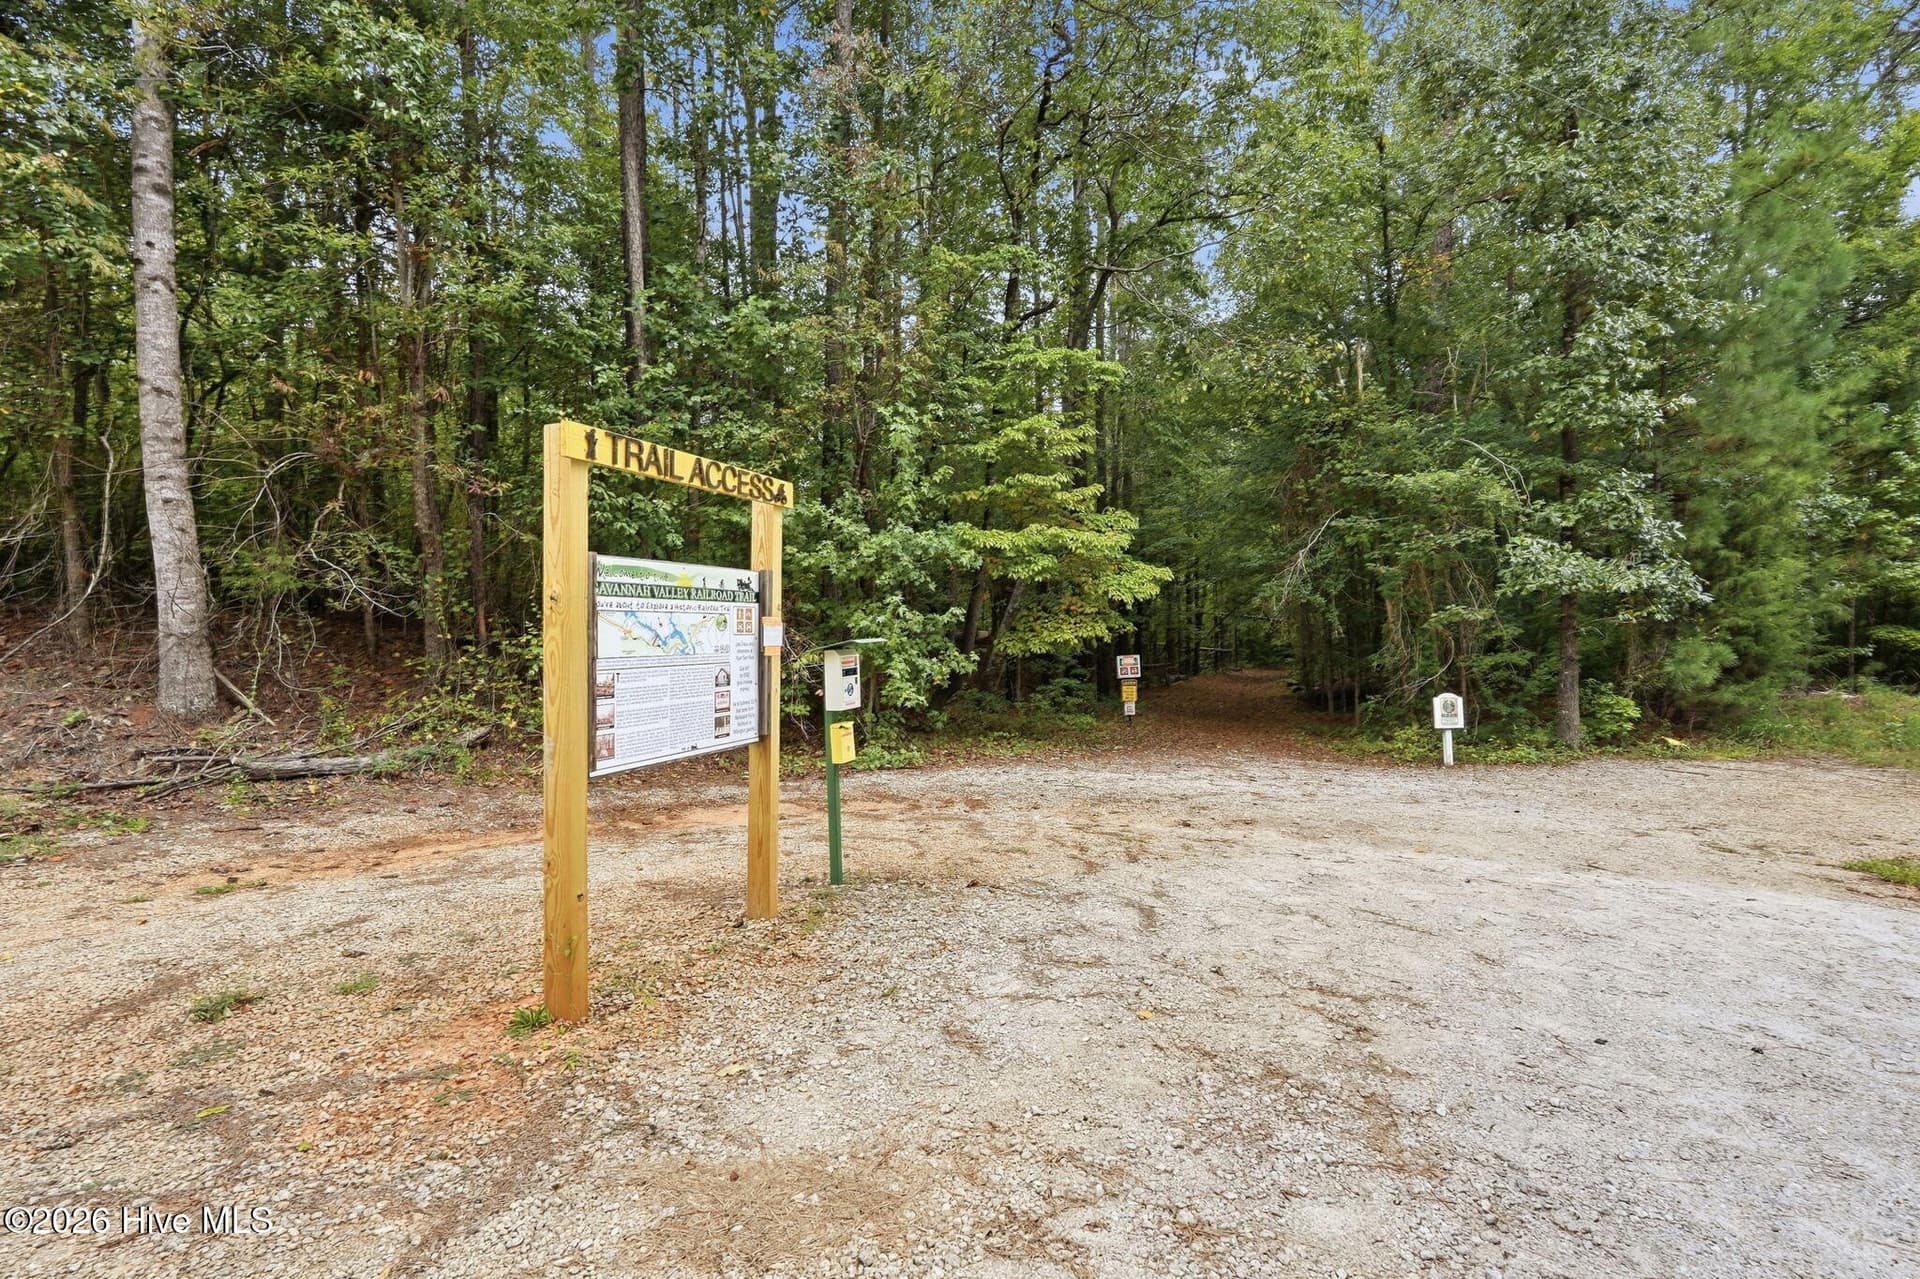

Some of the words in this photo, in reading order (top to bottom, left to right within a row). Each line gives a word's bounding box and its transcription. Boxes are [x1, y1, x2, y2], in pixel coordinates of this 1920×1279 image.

[605, 431, 684, 480] TRAIL
[689, 457, 774, 502] ACCESS
[654, 585, 689, 599] VALLEY
[691, 588, 733, 601] RAILROAD
[735, 591, 757, 602] TRAIL
